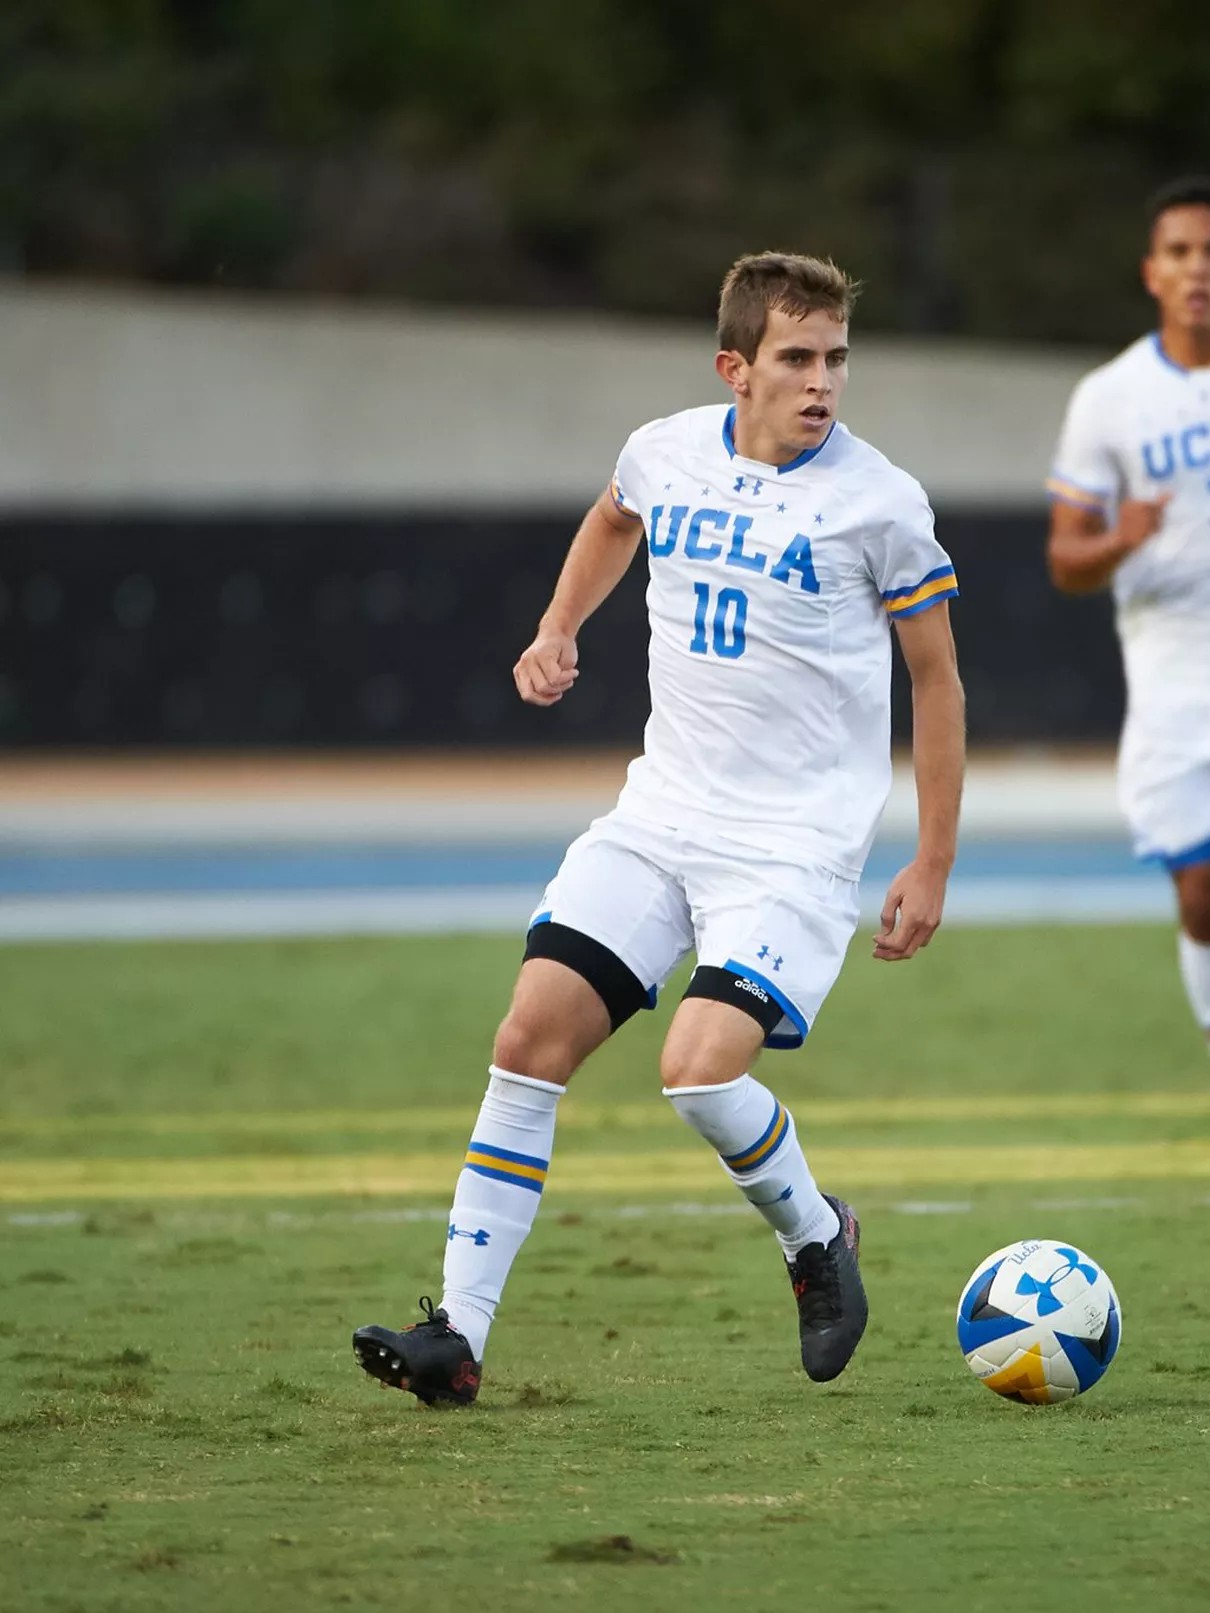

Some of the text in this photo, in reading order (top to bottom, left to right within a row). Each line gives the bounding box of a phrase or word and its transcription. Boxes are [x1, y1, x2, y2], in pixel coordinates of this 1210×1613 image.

[649, 505, 821, 595] UCLA
[690, 582, 748, 660] 10
[734, 978, 769, 1003] adidas
